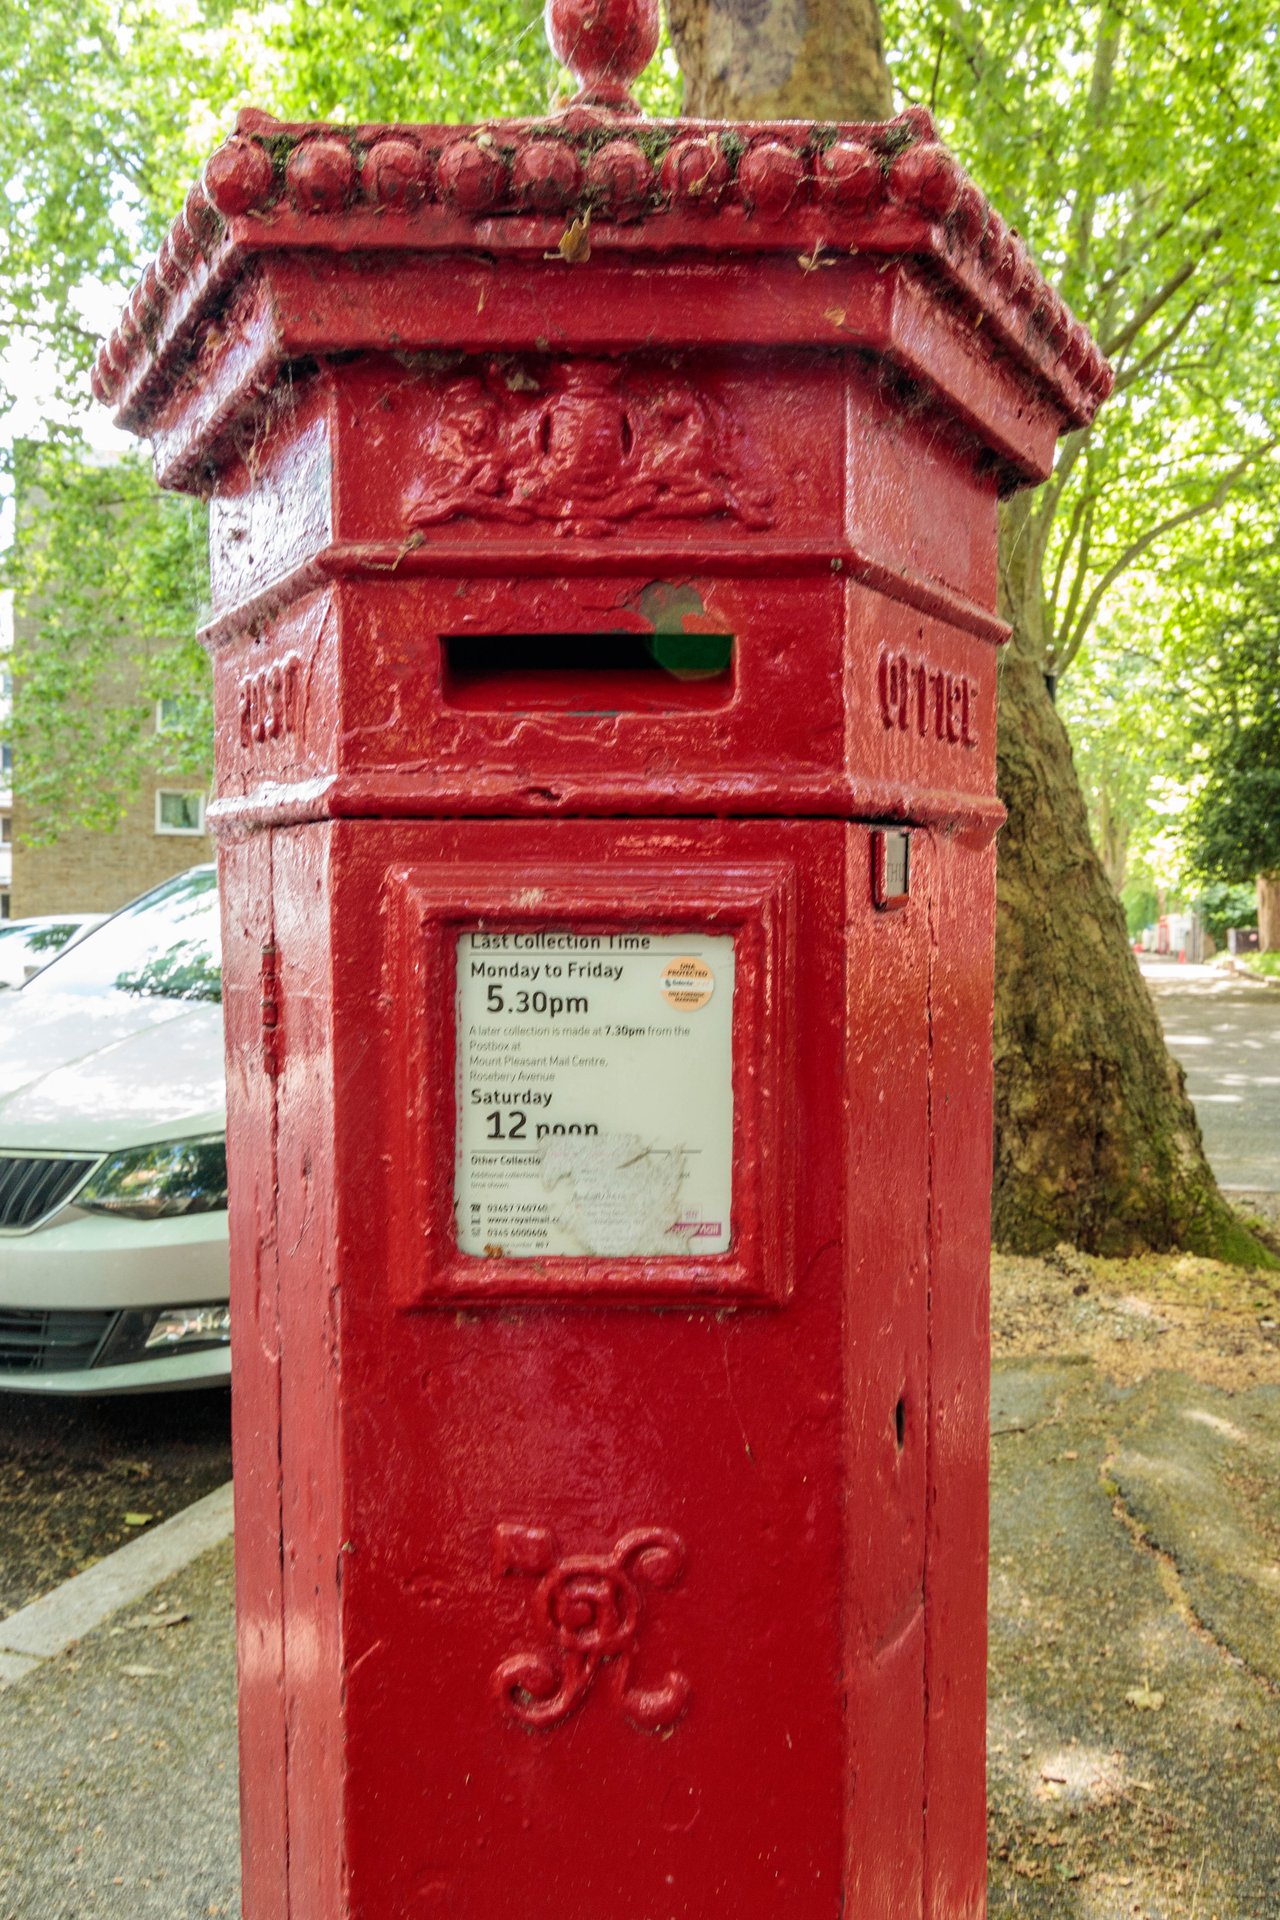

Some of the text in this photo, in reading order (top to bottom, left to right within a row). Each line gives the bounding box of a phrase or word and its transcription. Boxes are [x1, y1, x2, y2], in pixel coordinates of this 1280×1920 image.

[470, 933, 651, 950] Last Collection Time
[470, 962, 624, 981] Monday to Friday
[486, 984, 589, 1017] 5.30pm
[479, 1025, 501, 1036] later
[503, 1025, 551, 1036] collection
[552, 1025, 561, 1036] is
[562, 1025, 591, 1036] made
[592, 1026, 603, 1036] at
[605, 1025, 646, 1038] 7.30pm
[647, 1025, 673, 1036] from
[674, 1025, 690, 1036] the
[469, 1040, 509, 1051] Postbox
[470, 1055, 501, 1066] Mount
[504, 1055, 548, 1066] Pleasant
[550, 1055, 570, 1066] Mail
[469, 1070, 556, 1083] Rosebery Avenue
[471, 1088, 553, 1108] Saturday
[486, 1110, 527, 1139] 12
[471, 1155, 498, 1165] Other
